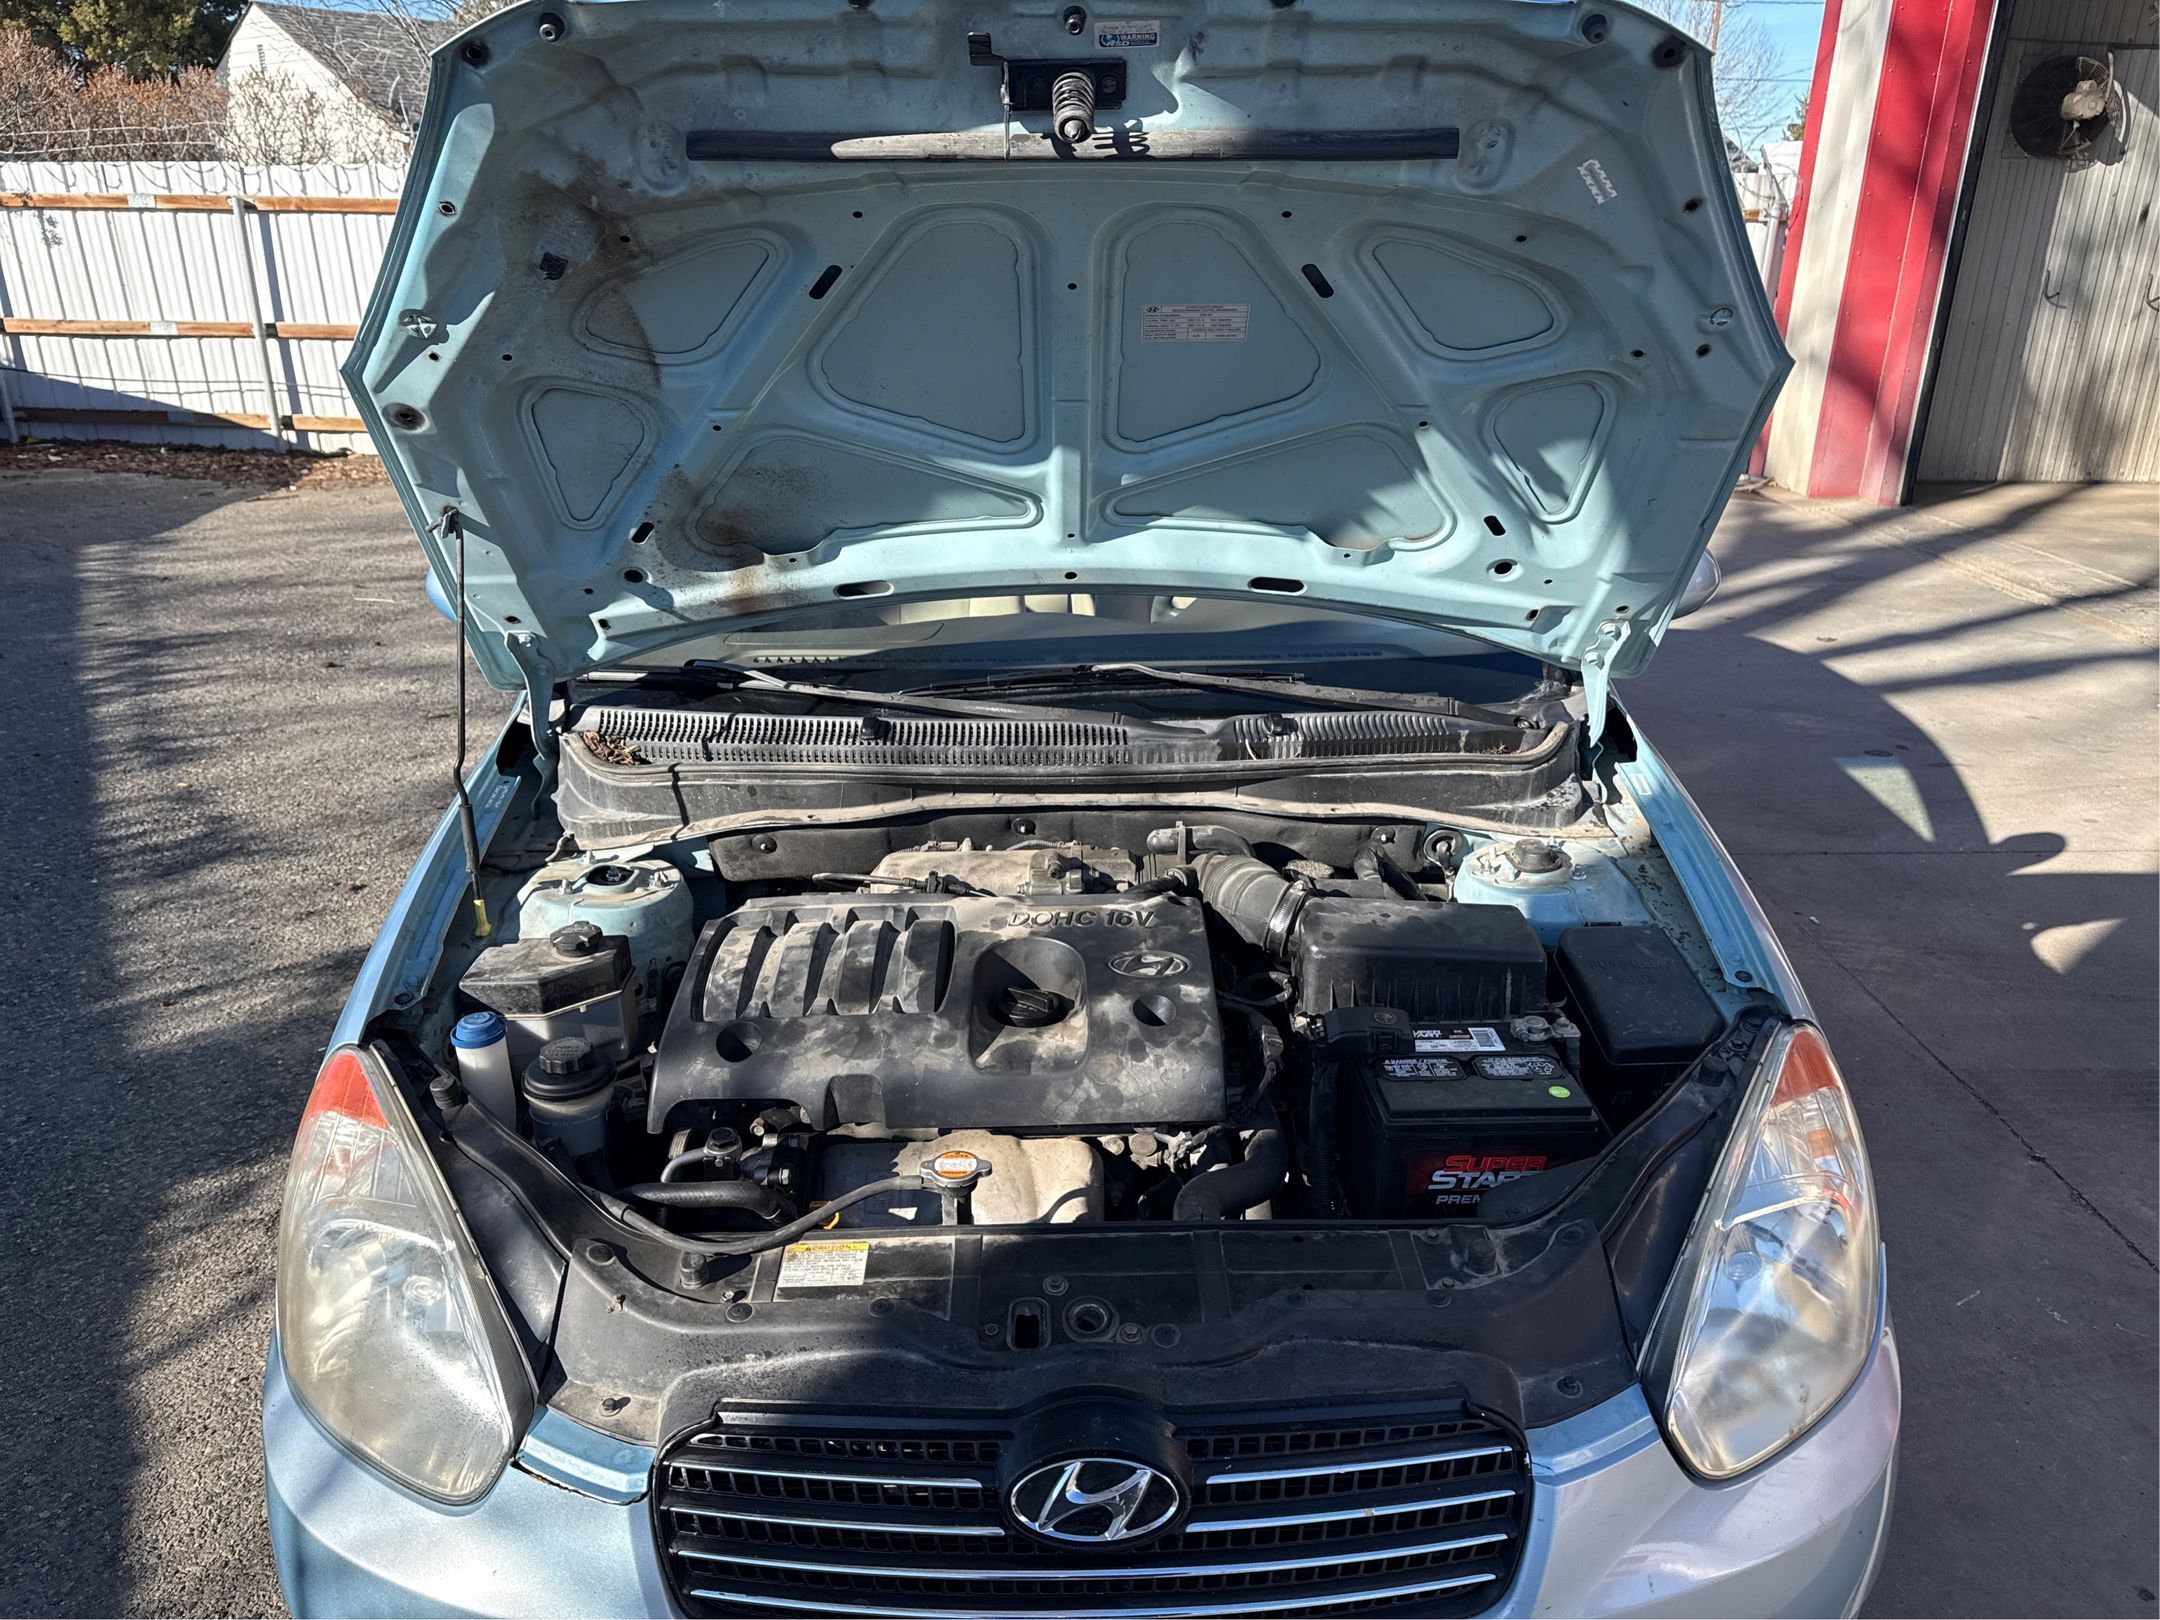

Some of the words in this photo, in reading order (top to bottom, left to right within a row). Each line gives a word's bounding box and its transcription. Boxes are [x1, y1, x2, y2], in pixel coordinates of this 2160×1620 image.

[1120, 33, 1155, 41] WARNING
[1008, 910, 1096, 927] DOHC
[1105, 910, 1156, 927] 16V
[1445, 1155, 1548, 1172] SUPER
[1427, 1170, 1544, 1190] STAR
